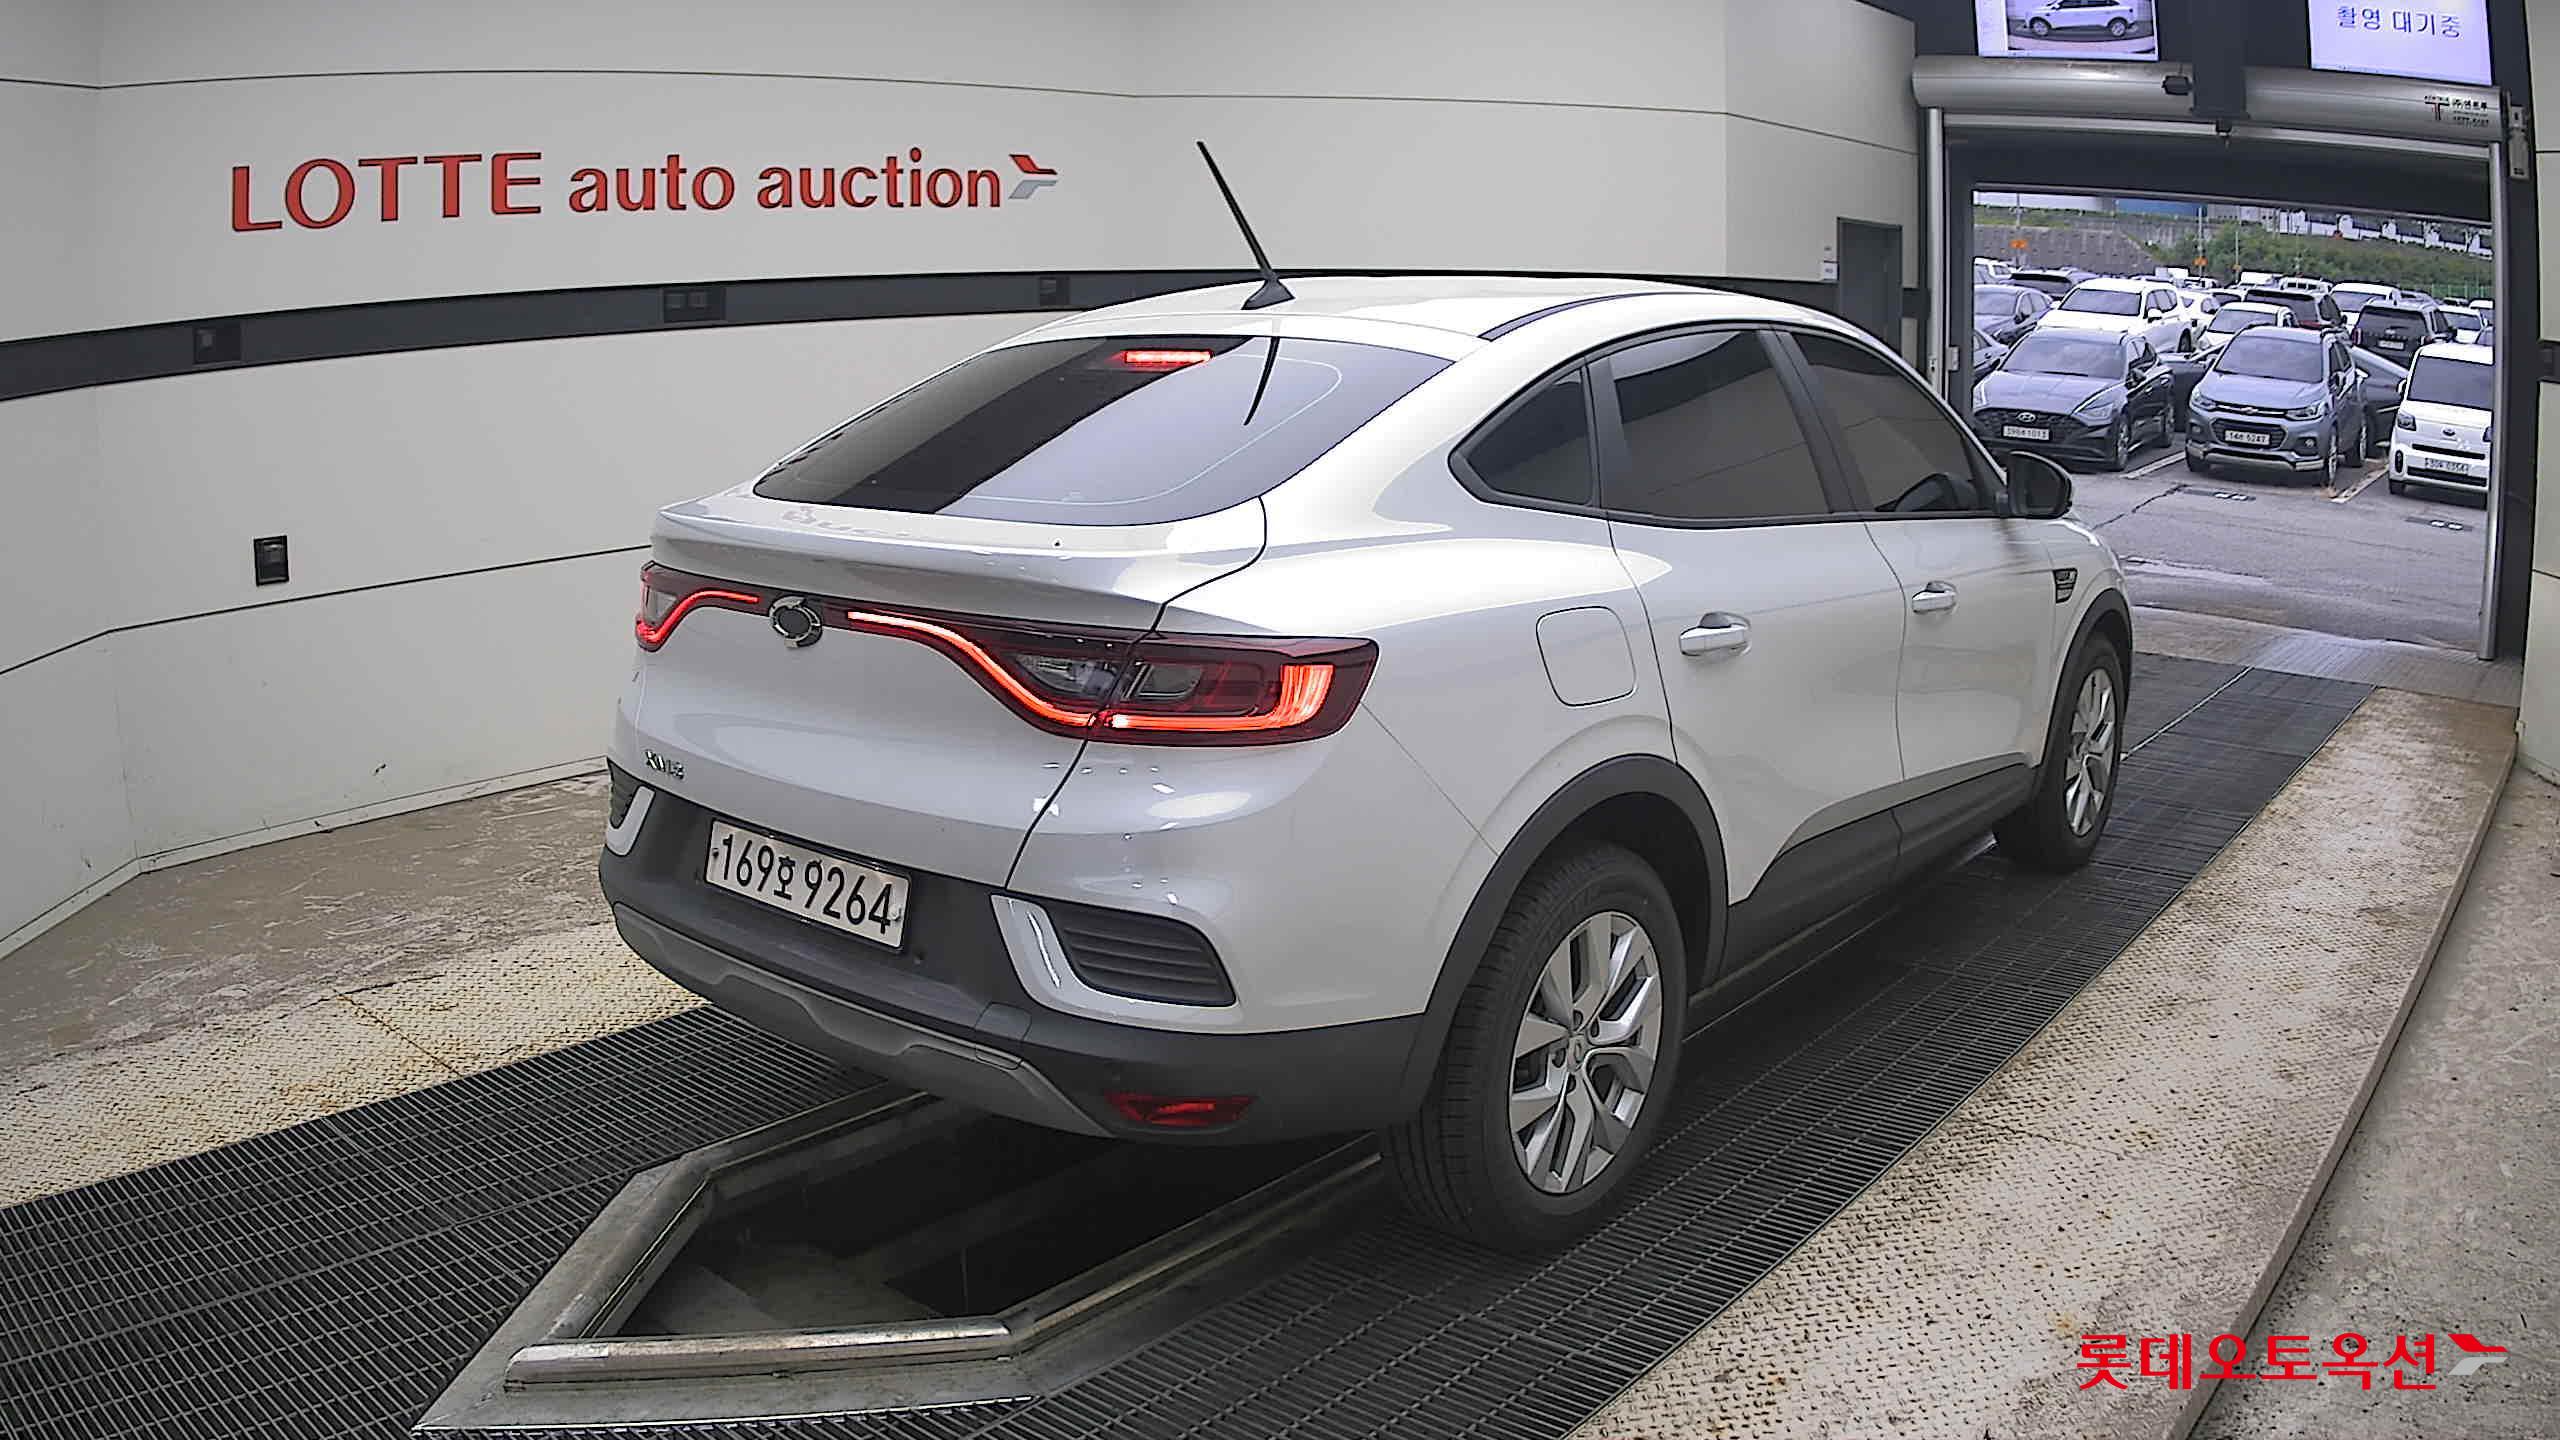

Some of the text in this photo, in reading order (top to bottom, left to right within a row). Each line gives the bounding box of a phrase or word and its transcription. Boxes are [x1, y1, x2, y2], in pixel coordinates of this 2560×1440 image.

[2338, 6, 2460, 38] 촬영 대기중
[231, 147, 1002, 233] LOTTE auto auction
[722, 833, 893, 935] 169호9264
